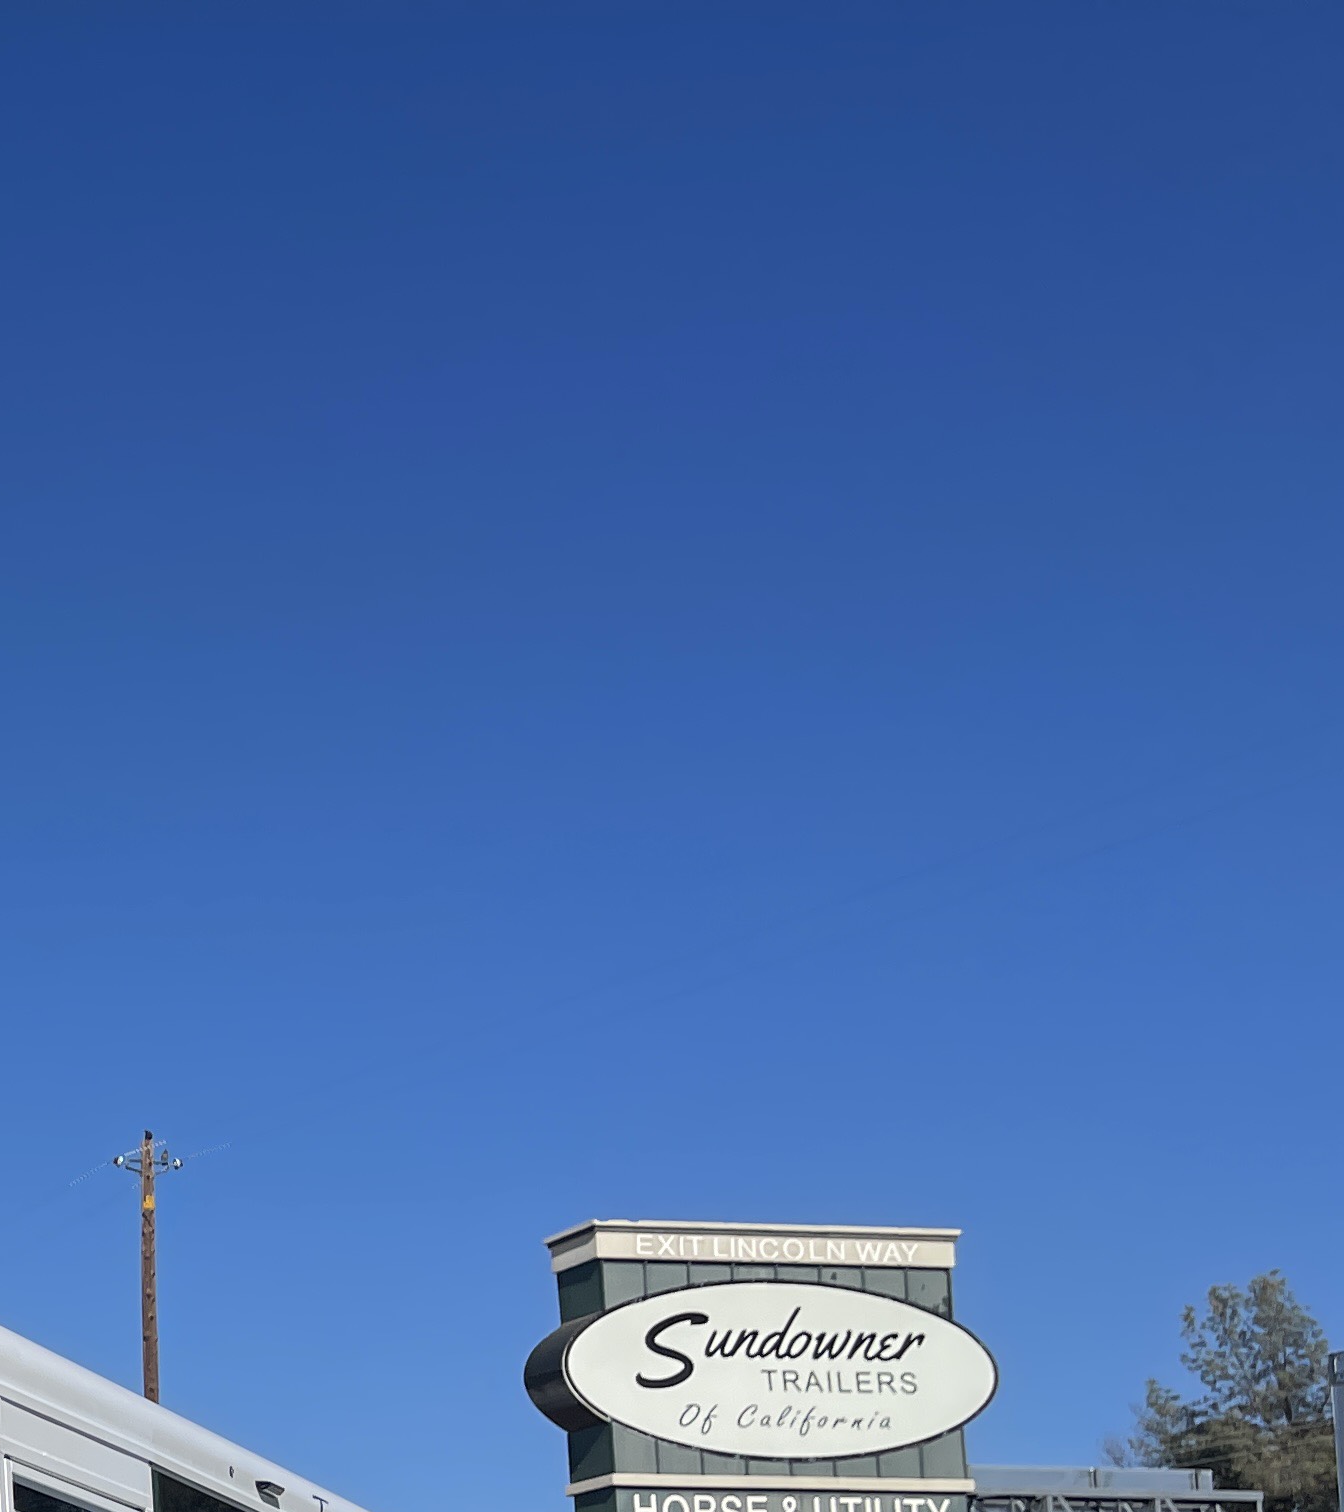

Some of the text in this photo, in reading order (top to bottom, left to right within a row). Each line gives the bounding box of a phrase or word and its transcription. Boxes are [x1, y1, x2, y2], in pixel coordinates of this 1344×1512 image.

[634, 1233, 920, 1263] EXIT LINCOLN WAY
[635, 1306, 926, 1388] Sundowner
[760, 1368, 919, 1395] TRAILERS
[678, 1403, 892, 1436] Of California
